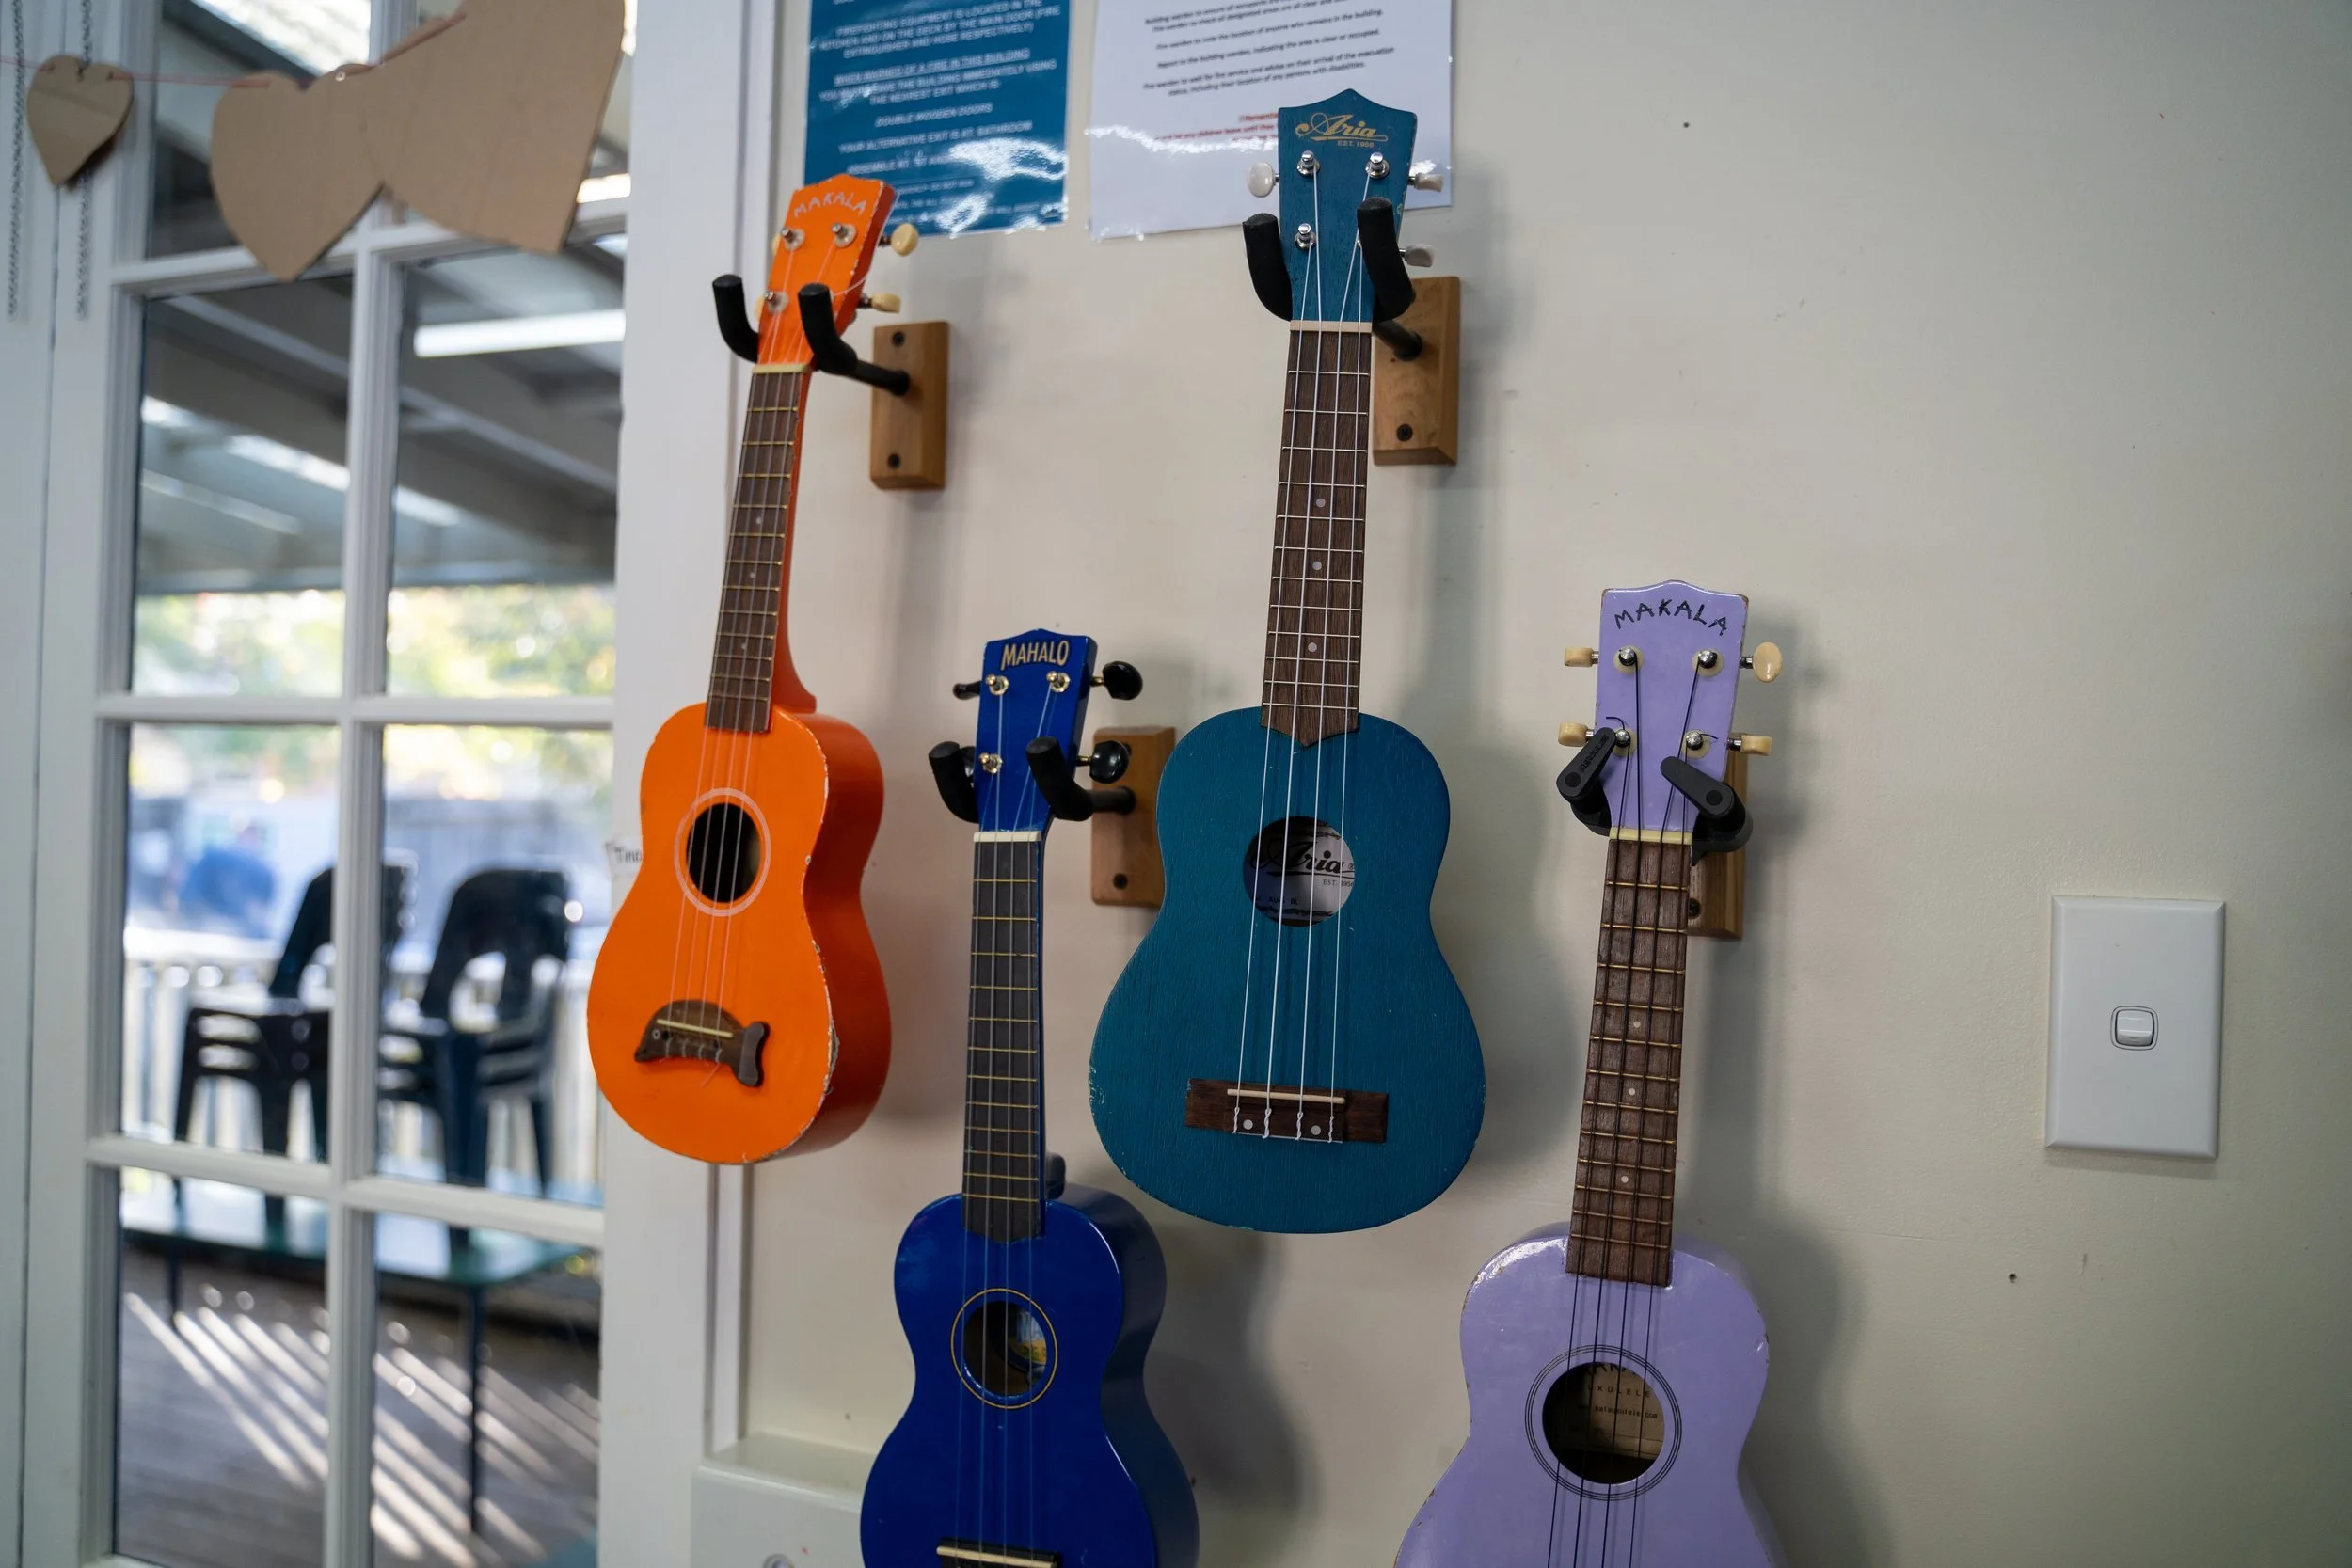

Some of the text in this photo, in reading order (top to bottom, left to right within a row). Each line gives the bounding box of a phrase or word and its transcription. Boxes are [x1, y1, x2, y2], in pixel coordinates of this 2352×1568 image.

[874, 102, 993, 128] DOUBLE WOODEN DOORS
[1295, 113, 1376, 138] Aria
[794, 191, 866, 218] MAKALA
[1614, 598, 1727, 636] MAKALA
[1001, 641, 1069, 671] MAHALO
